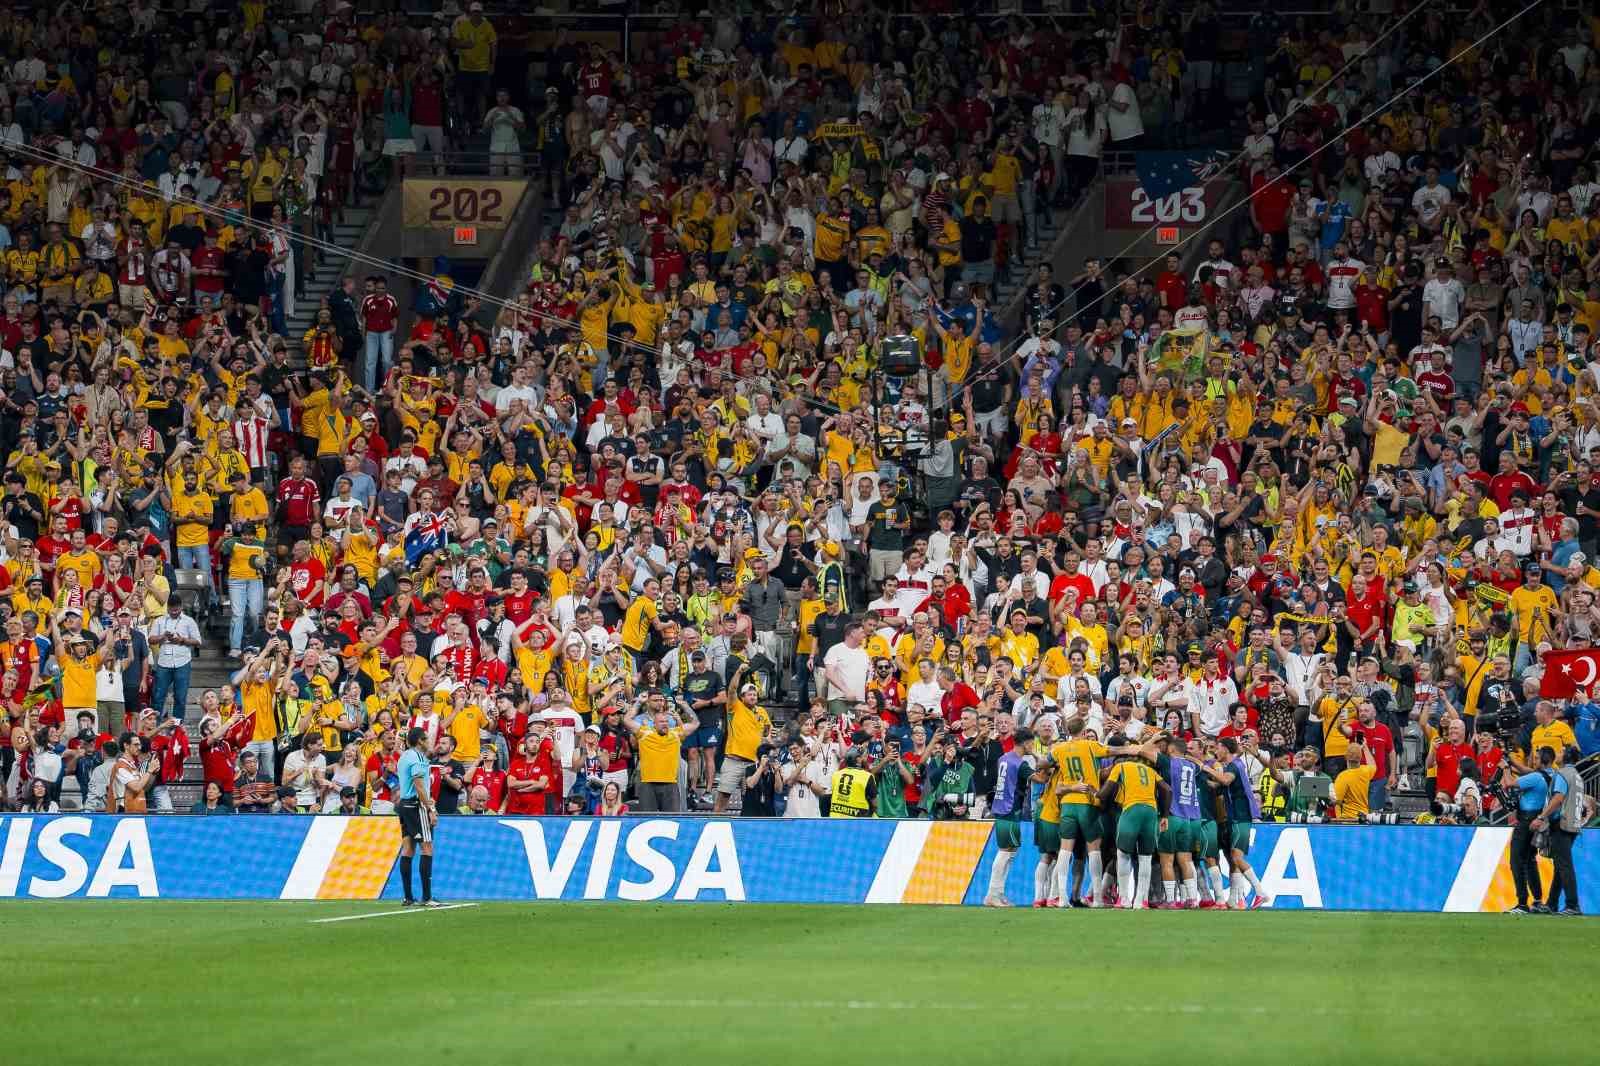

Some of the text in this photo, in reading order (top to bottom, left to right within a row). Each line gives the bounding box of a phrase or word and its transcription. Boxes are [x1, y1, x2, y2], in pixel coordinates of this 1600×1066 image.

[589, 78, 600, 89] 10
[429, 187, 504, 223] 202
[1130, 187, 1206, 223] 203
[1208, 696, 1214, 705] 9
[1067, 756, 1083, 778] 19
[1137, 763, 1149, 786] 9
[831, 804, 860, 816] ECURITY
[0, 817, 160, 898] ISA
[498, 819, 746, 901] VISA
